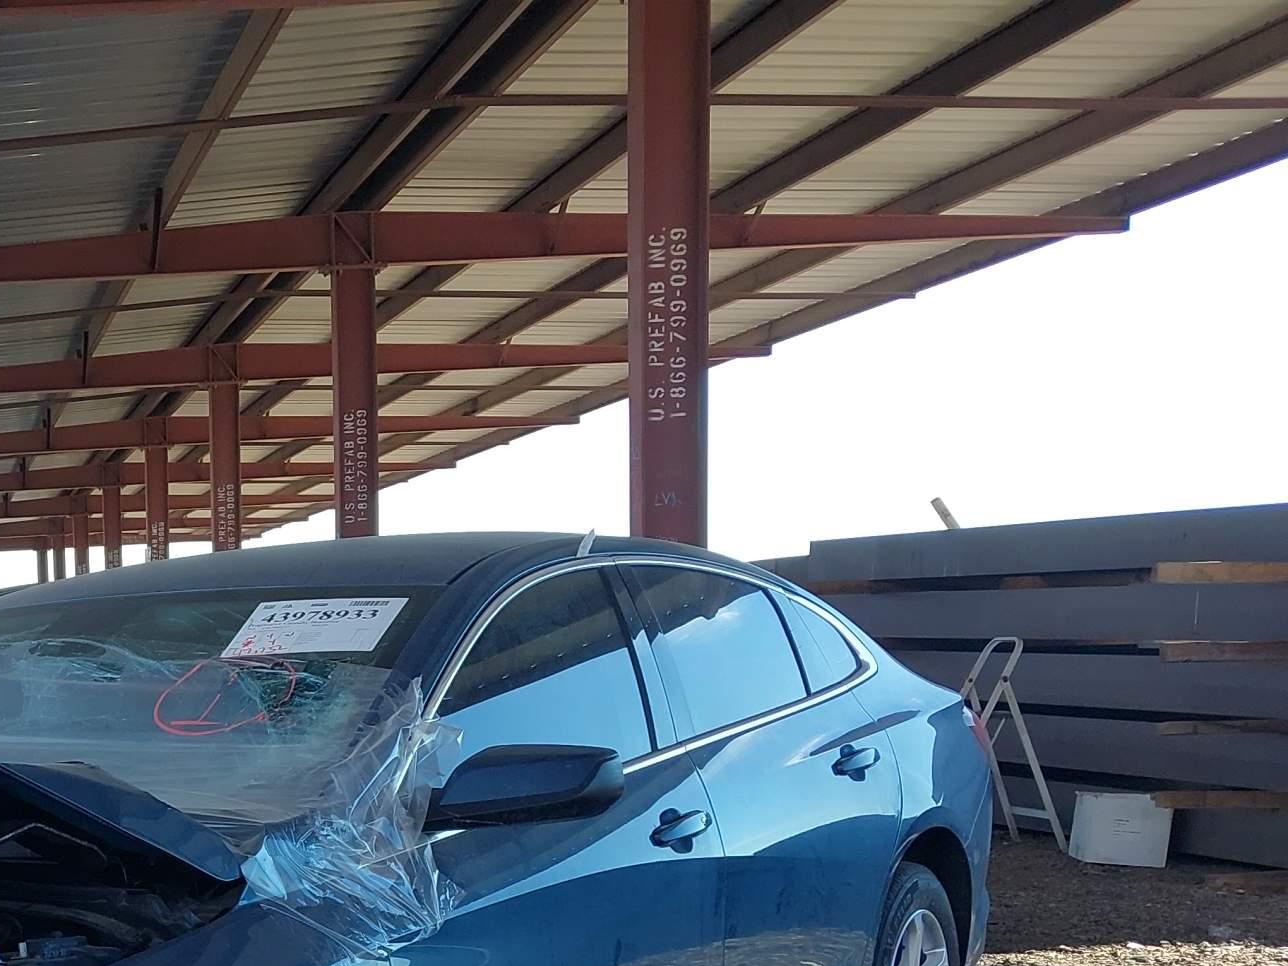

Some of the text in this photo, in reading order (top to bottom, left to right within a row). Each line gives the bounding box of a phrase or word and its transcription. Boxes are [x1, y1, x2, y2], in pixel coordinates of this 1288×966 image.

[648, 226, 666, 268] INC.
[648, 281, 665, 366] PREFAB
[670, 227, 687, 418] 1-866-799-0969
[344, 441, 355, 491] PREFAB
[261, 609, 380, 624] 43978933
